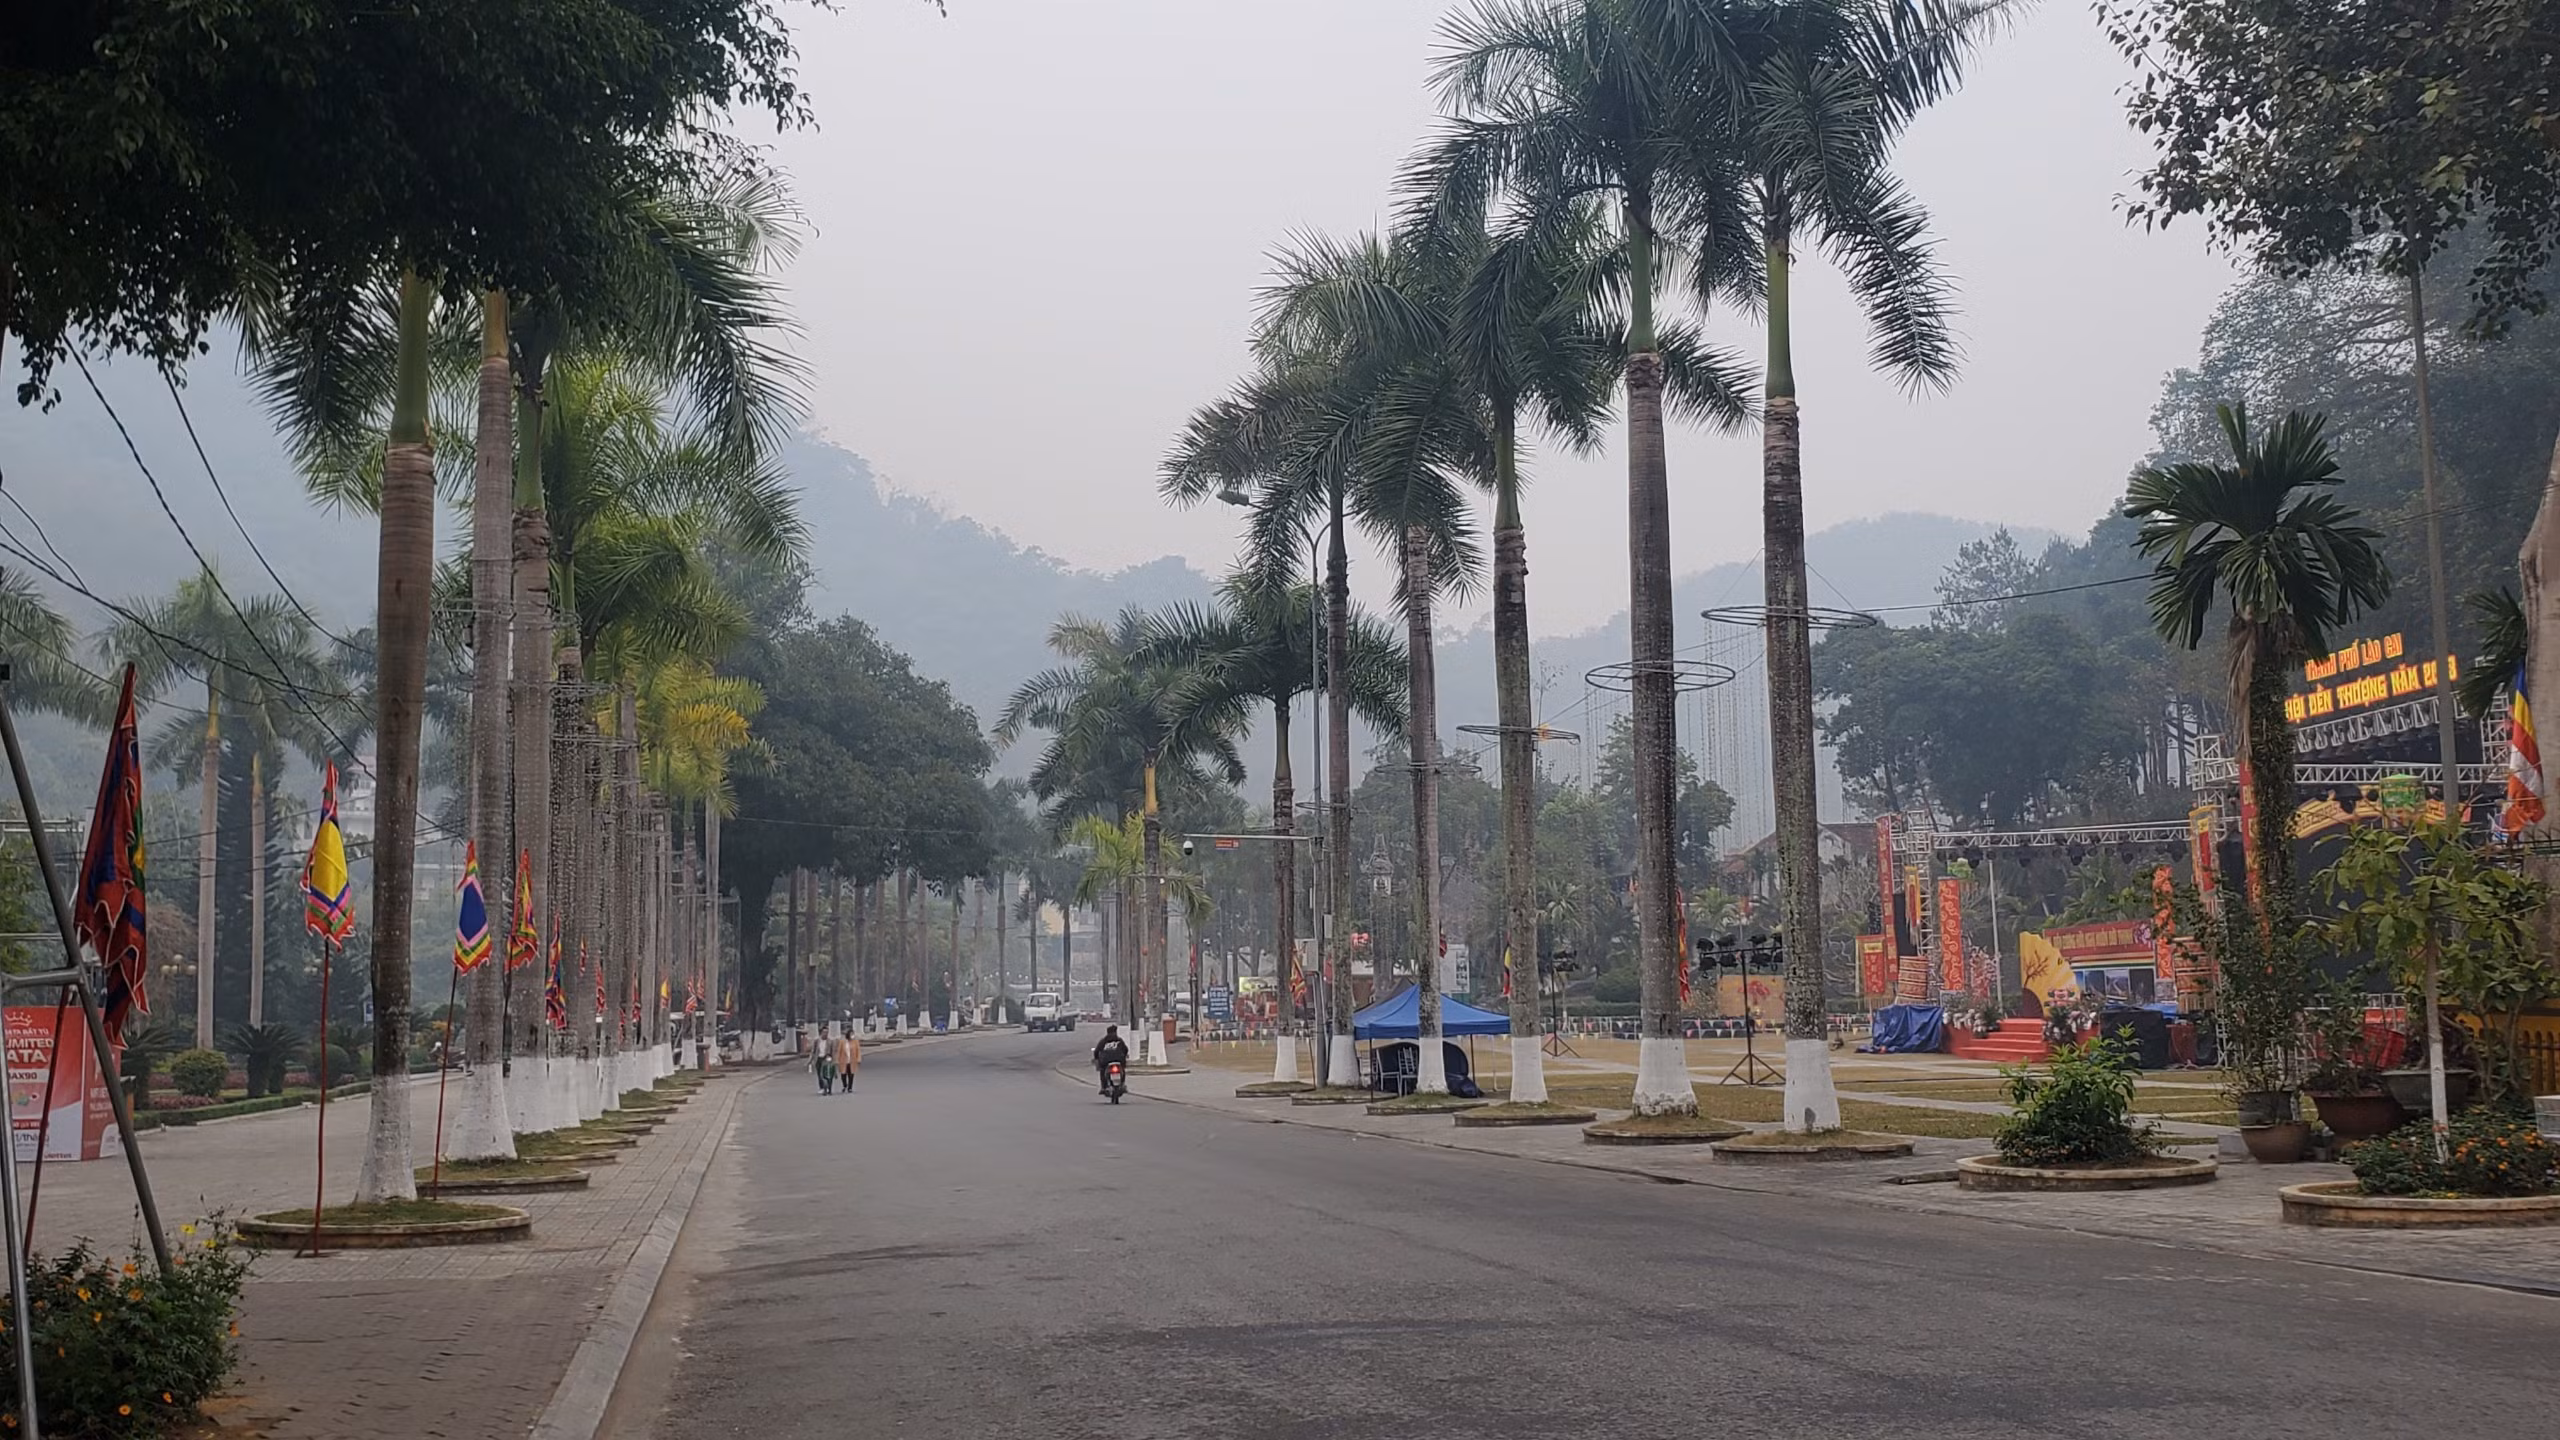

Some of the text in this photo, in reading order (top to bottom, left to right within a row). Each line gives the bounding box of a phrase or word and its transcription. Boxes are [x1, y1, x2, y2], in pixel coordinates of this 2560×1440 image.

[2338, 638, 2360, 672] PHỐ
[2361, 637, 2382, 666] LÀO
[2384, 633, 2403, 658] CAI
[2336, 674, 2389, 708] THƯỢNG
[2390, 663, 2423, 696] NĂM
[2423, 655, 2458, 688] 203
[6, 1037, 54, 1049] IMITED
[7, 1049, 47, 1063] ATA
